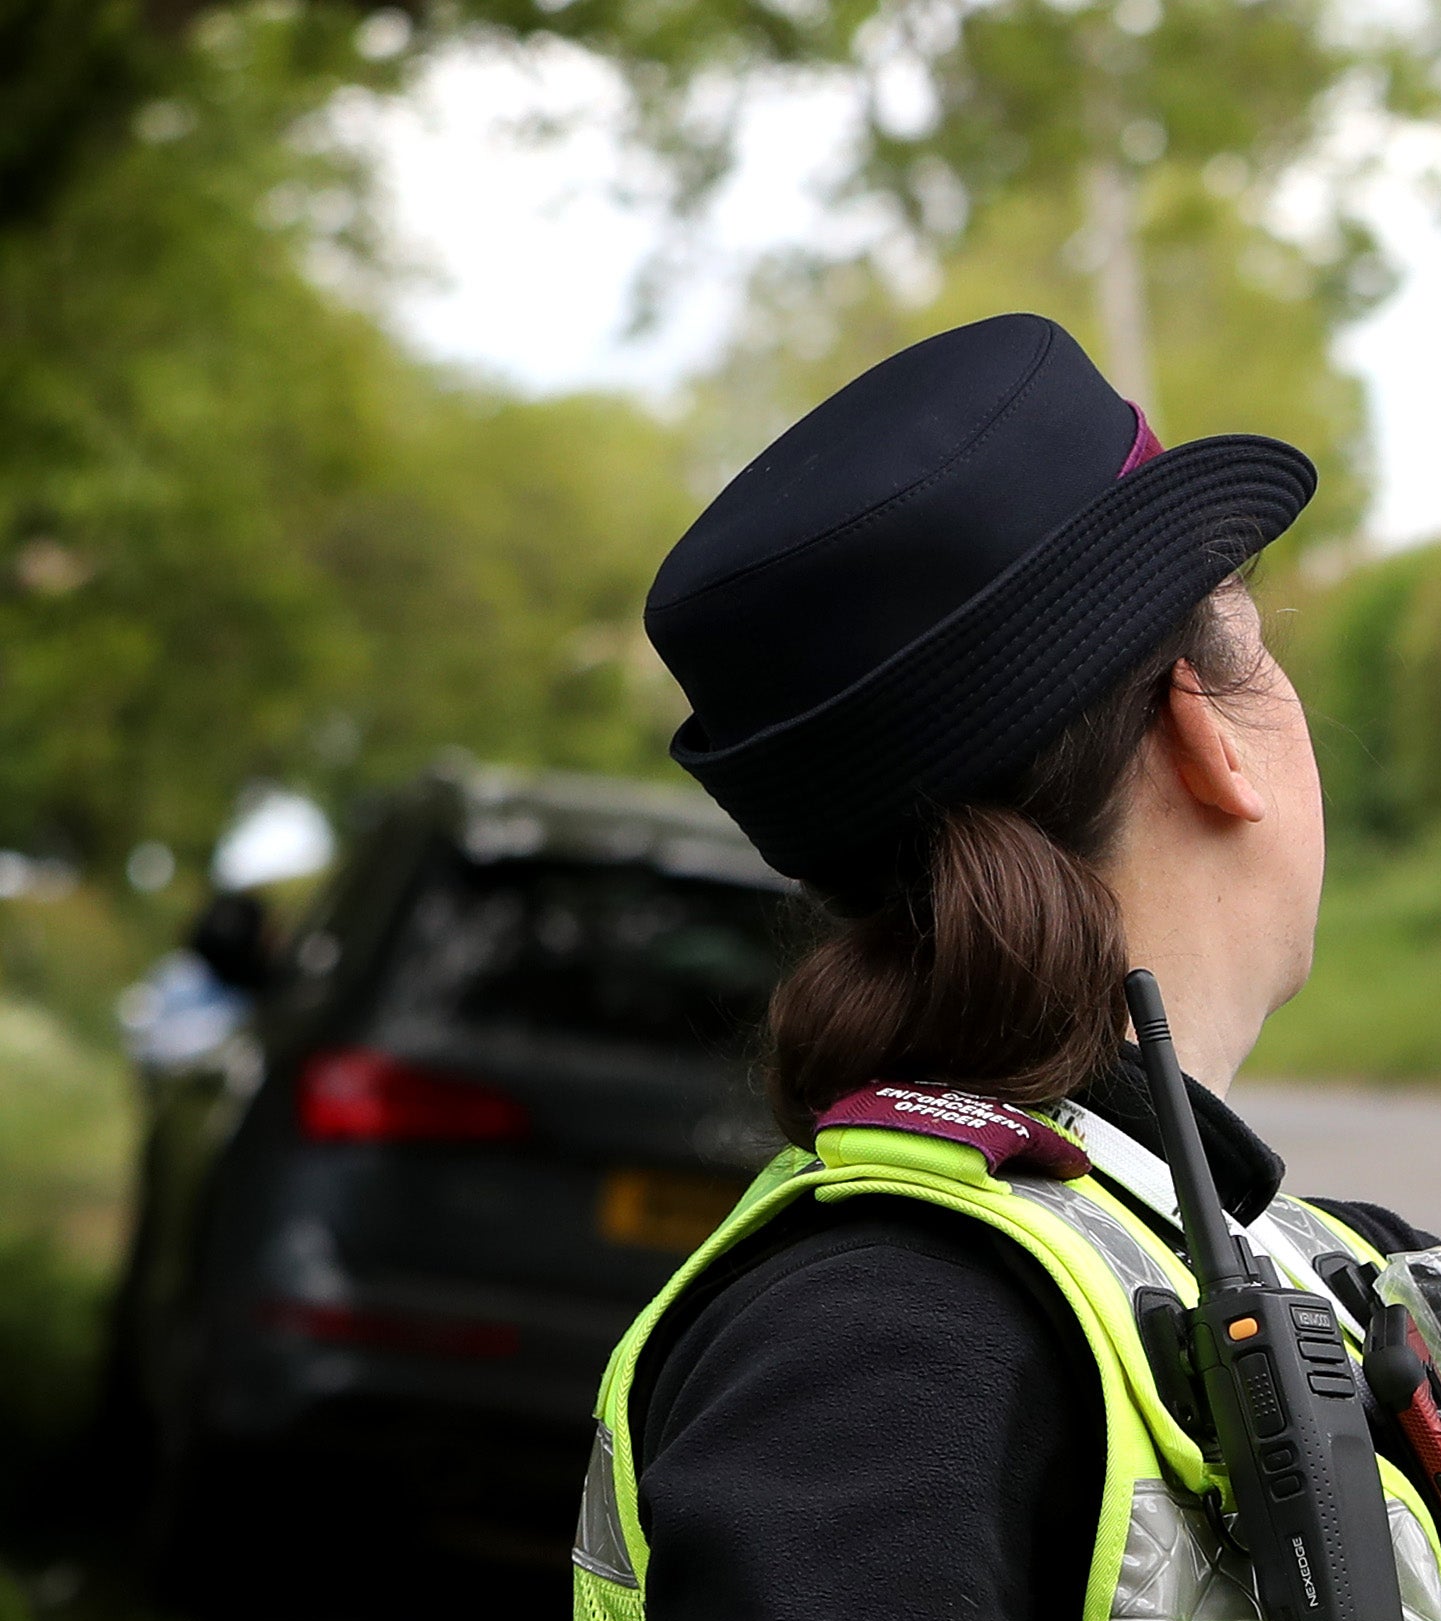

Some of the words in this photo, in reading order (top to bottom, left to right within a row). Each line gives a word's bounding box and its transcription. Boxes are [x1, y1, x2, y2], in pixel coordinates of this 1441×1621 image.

[875, 1087, 1030, 1139] ENFORCEMENT
[894, 1101, 987, 1129] OFFICER
[1292, 1536, 1319, 1607] NEXEDGE
